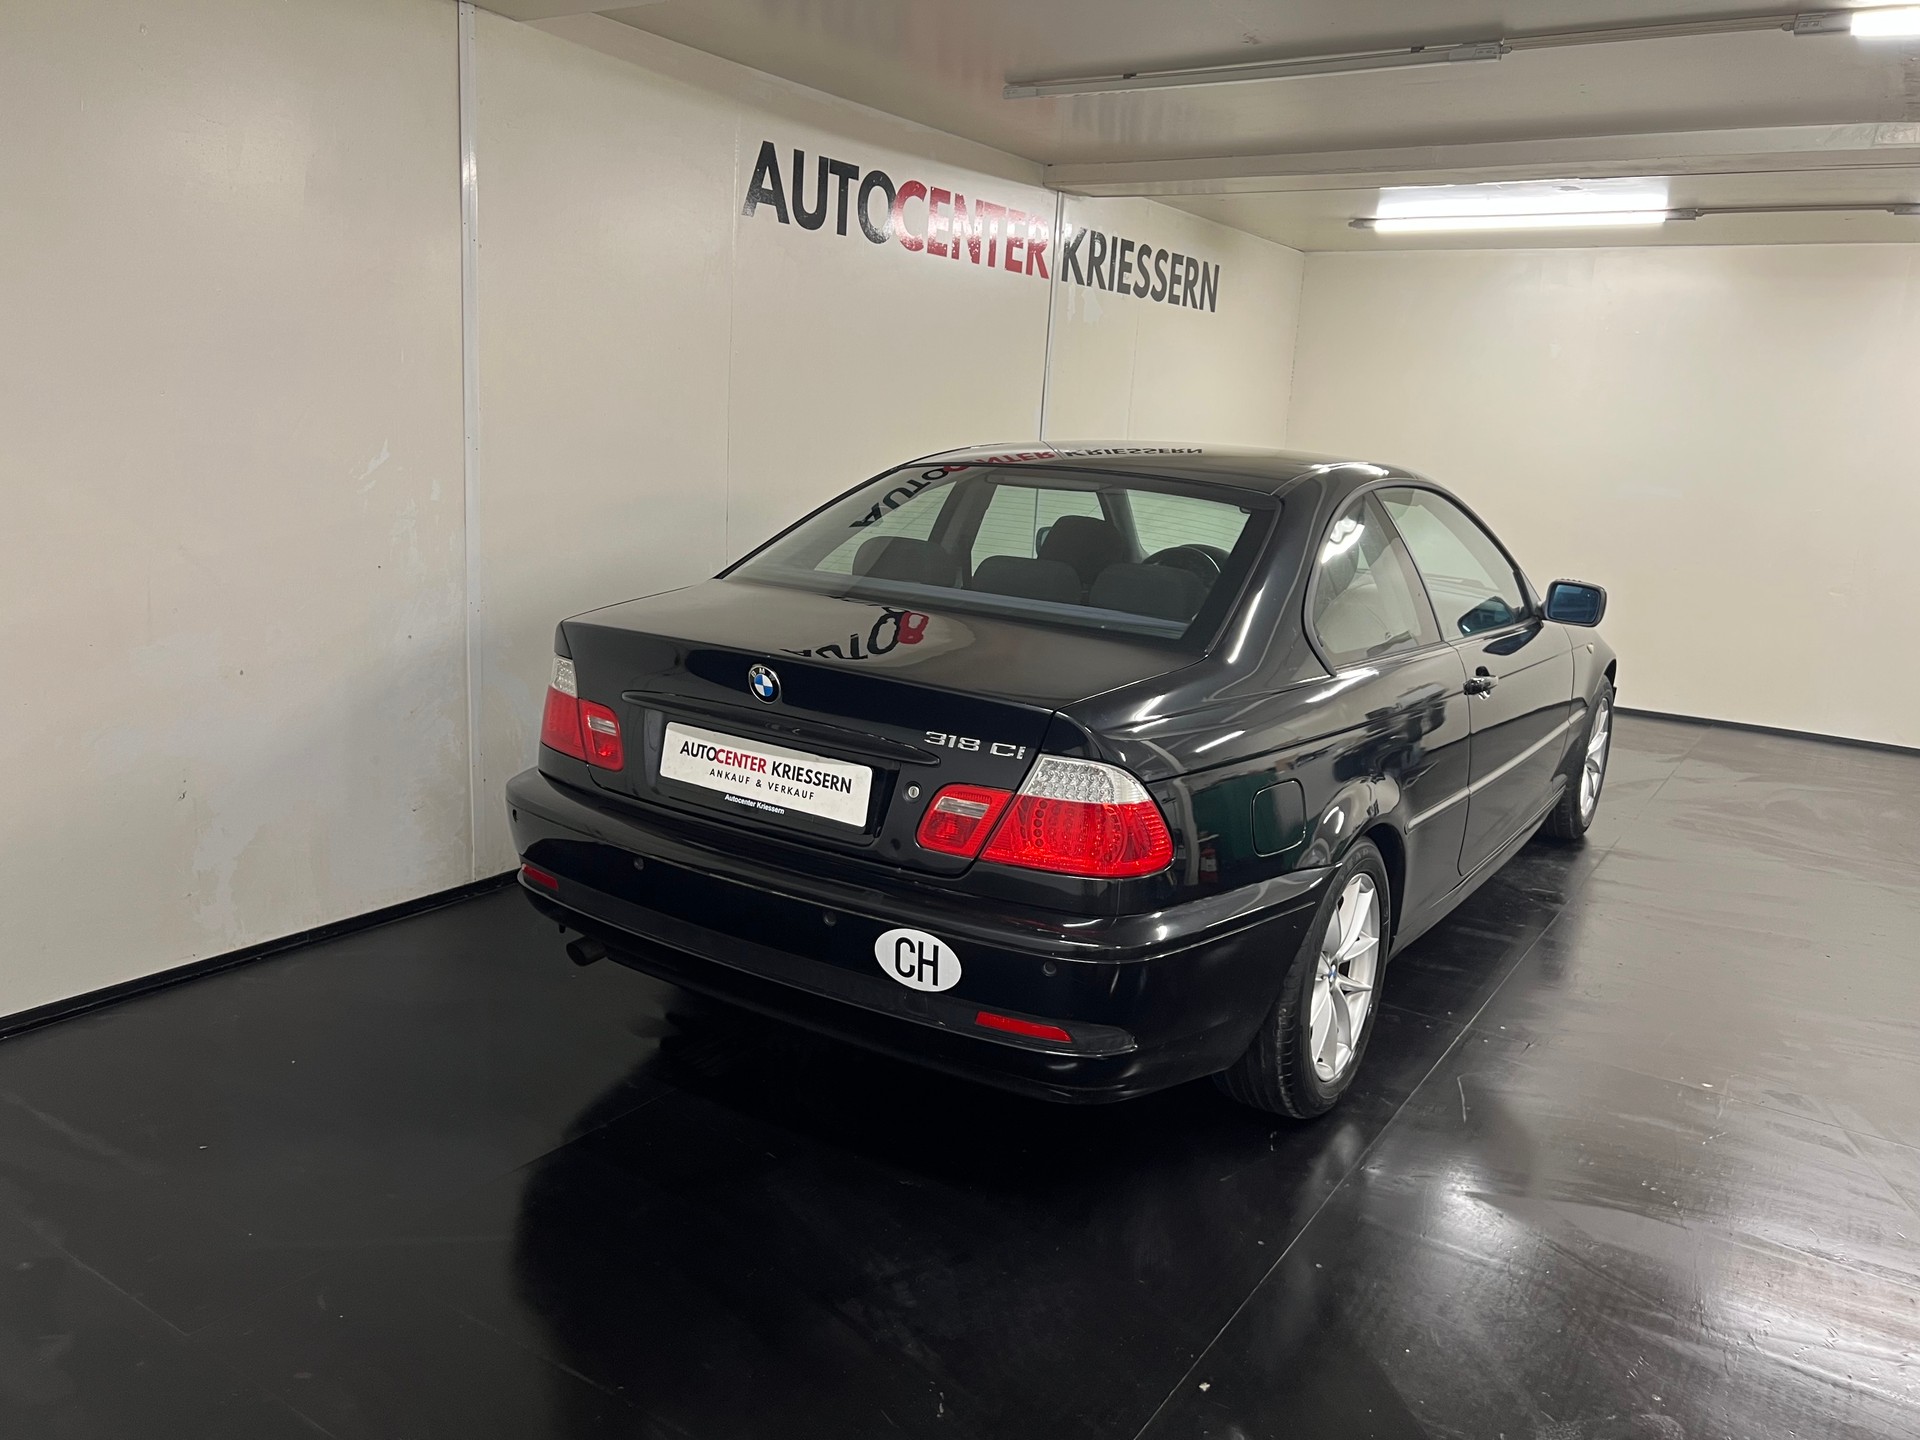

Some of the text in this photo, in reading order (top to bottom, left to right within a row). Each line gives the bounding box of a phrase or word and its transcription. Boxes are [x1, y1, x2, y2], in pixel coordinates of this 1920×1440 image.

[741, 140, 1221, 313] AUTOCENTER KRIESSERN
[924, 731, 981, 752] 318
[679, 740, 853, 794] AUTOCENTER KRIESSERN
[709, 768, 815, 801] ANKAUF & VERKAUF
[724, 793, 785, 815] Autocenter Kriessern
[895, 936, 939, 987] CH
